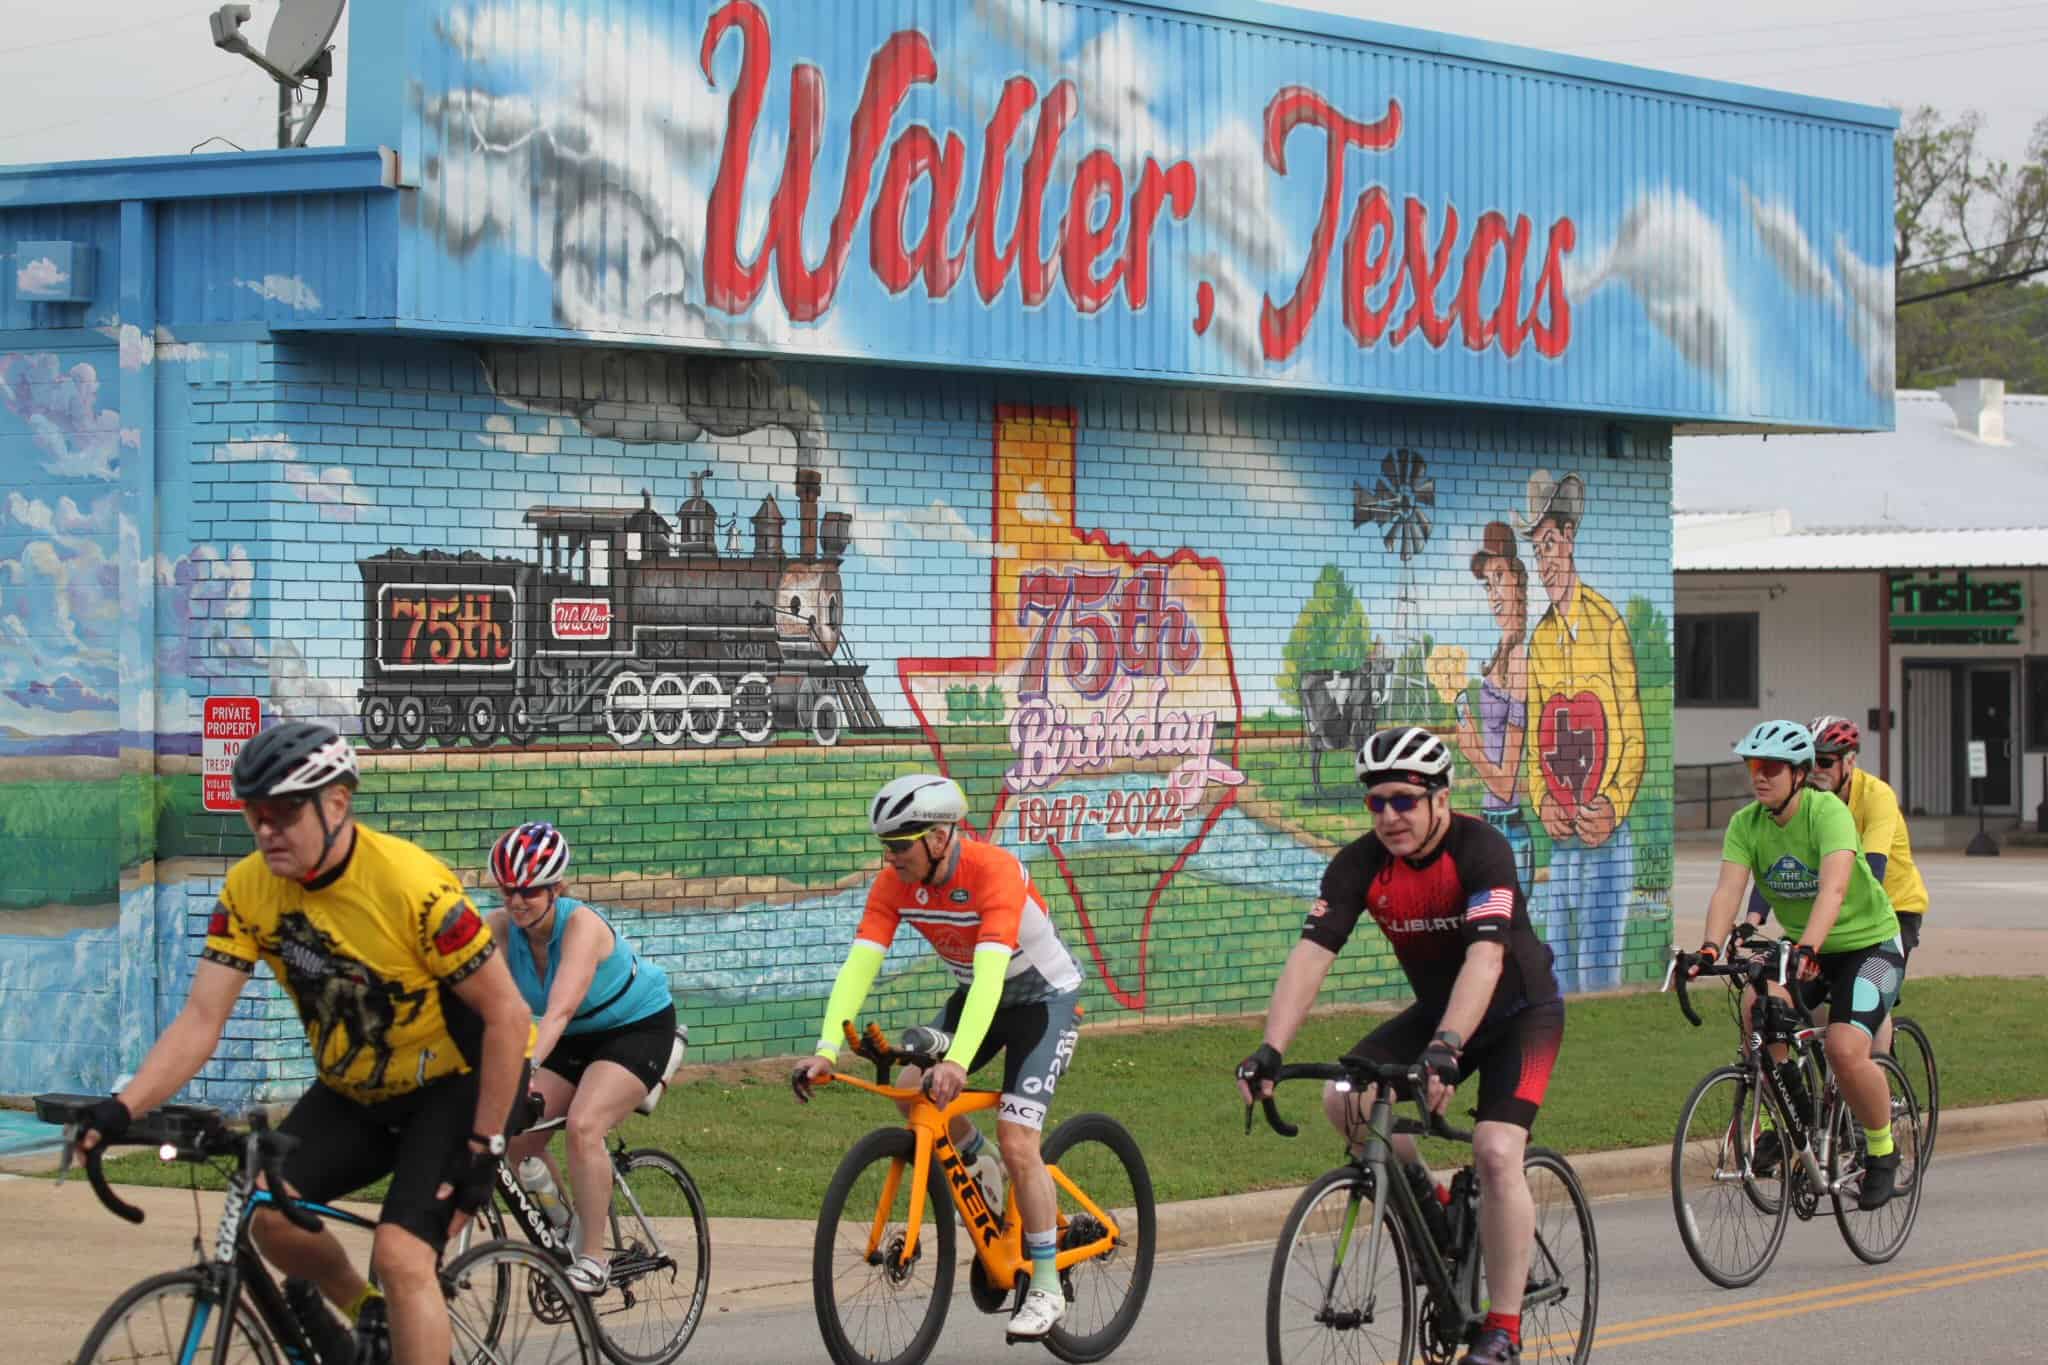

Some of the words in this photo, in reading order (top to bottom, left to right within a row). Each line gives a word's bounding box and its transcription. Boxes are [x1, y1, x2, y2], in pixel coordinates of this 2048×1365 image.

[1260, 86, 1575, 362] Texas
[391, 594, 511, 664] 75th
[556, 606, 614, 632] Waller
[1018, 565, 1200, 700] 75th
[207, 721, 257, 736] PROPERTY
[212, 706, 252, 721] PRIVATE
[223, 741, 240, 756] NO
[1005, 675, 1248, 808] Birthday
[1780, 872, 1801, 881] THE
[215, 1182, 243, 1262] GIANT
[935, 1135, 1001, 1249] TREK
